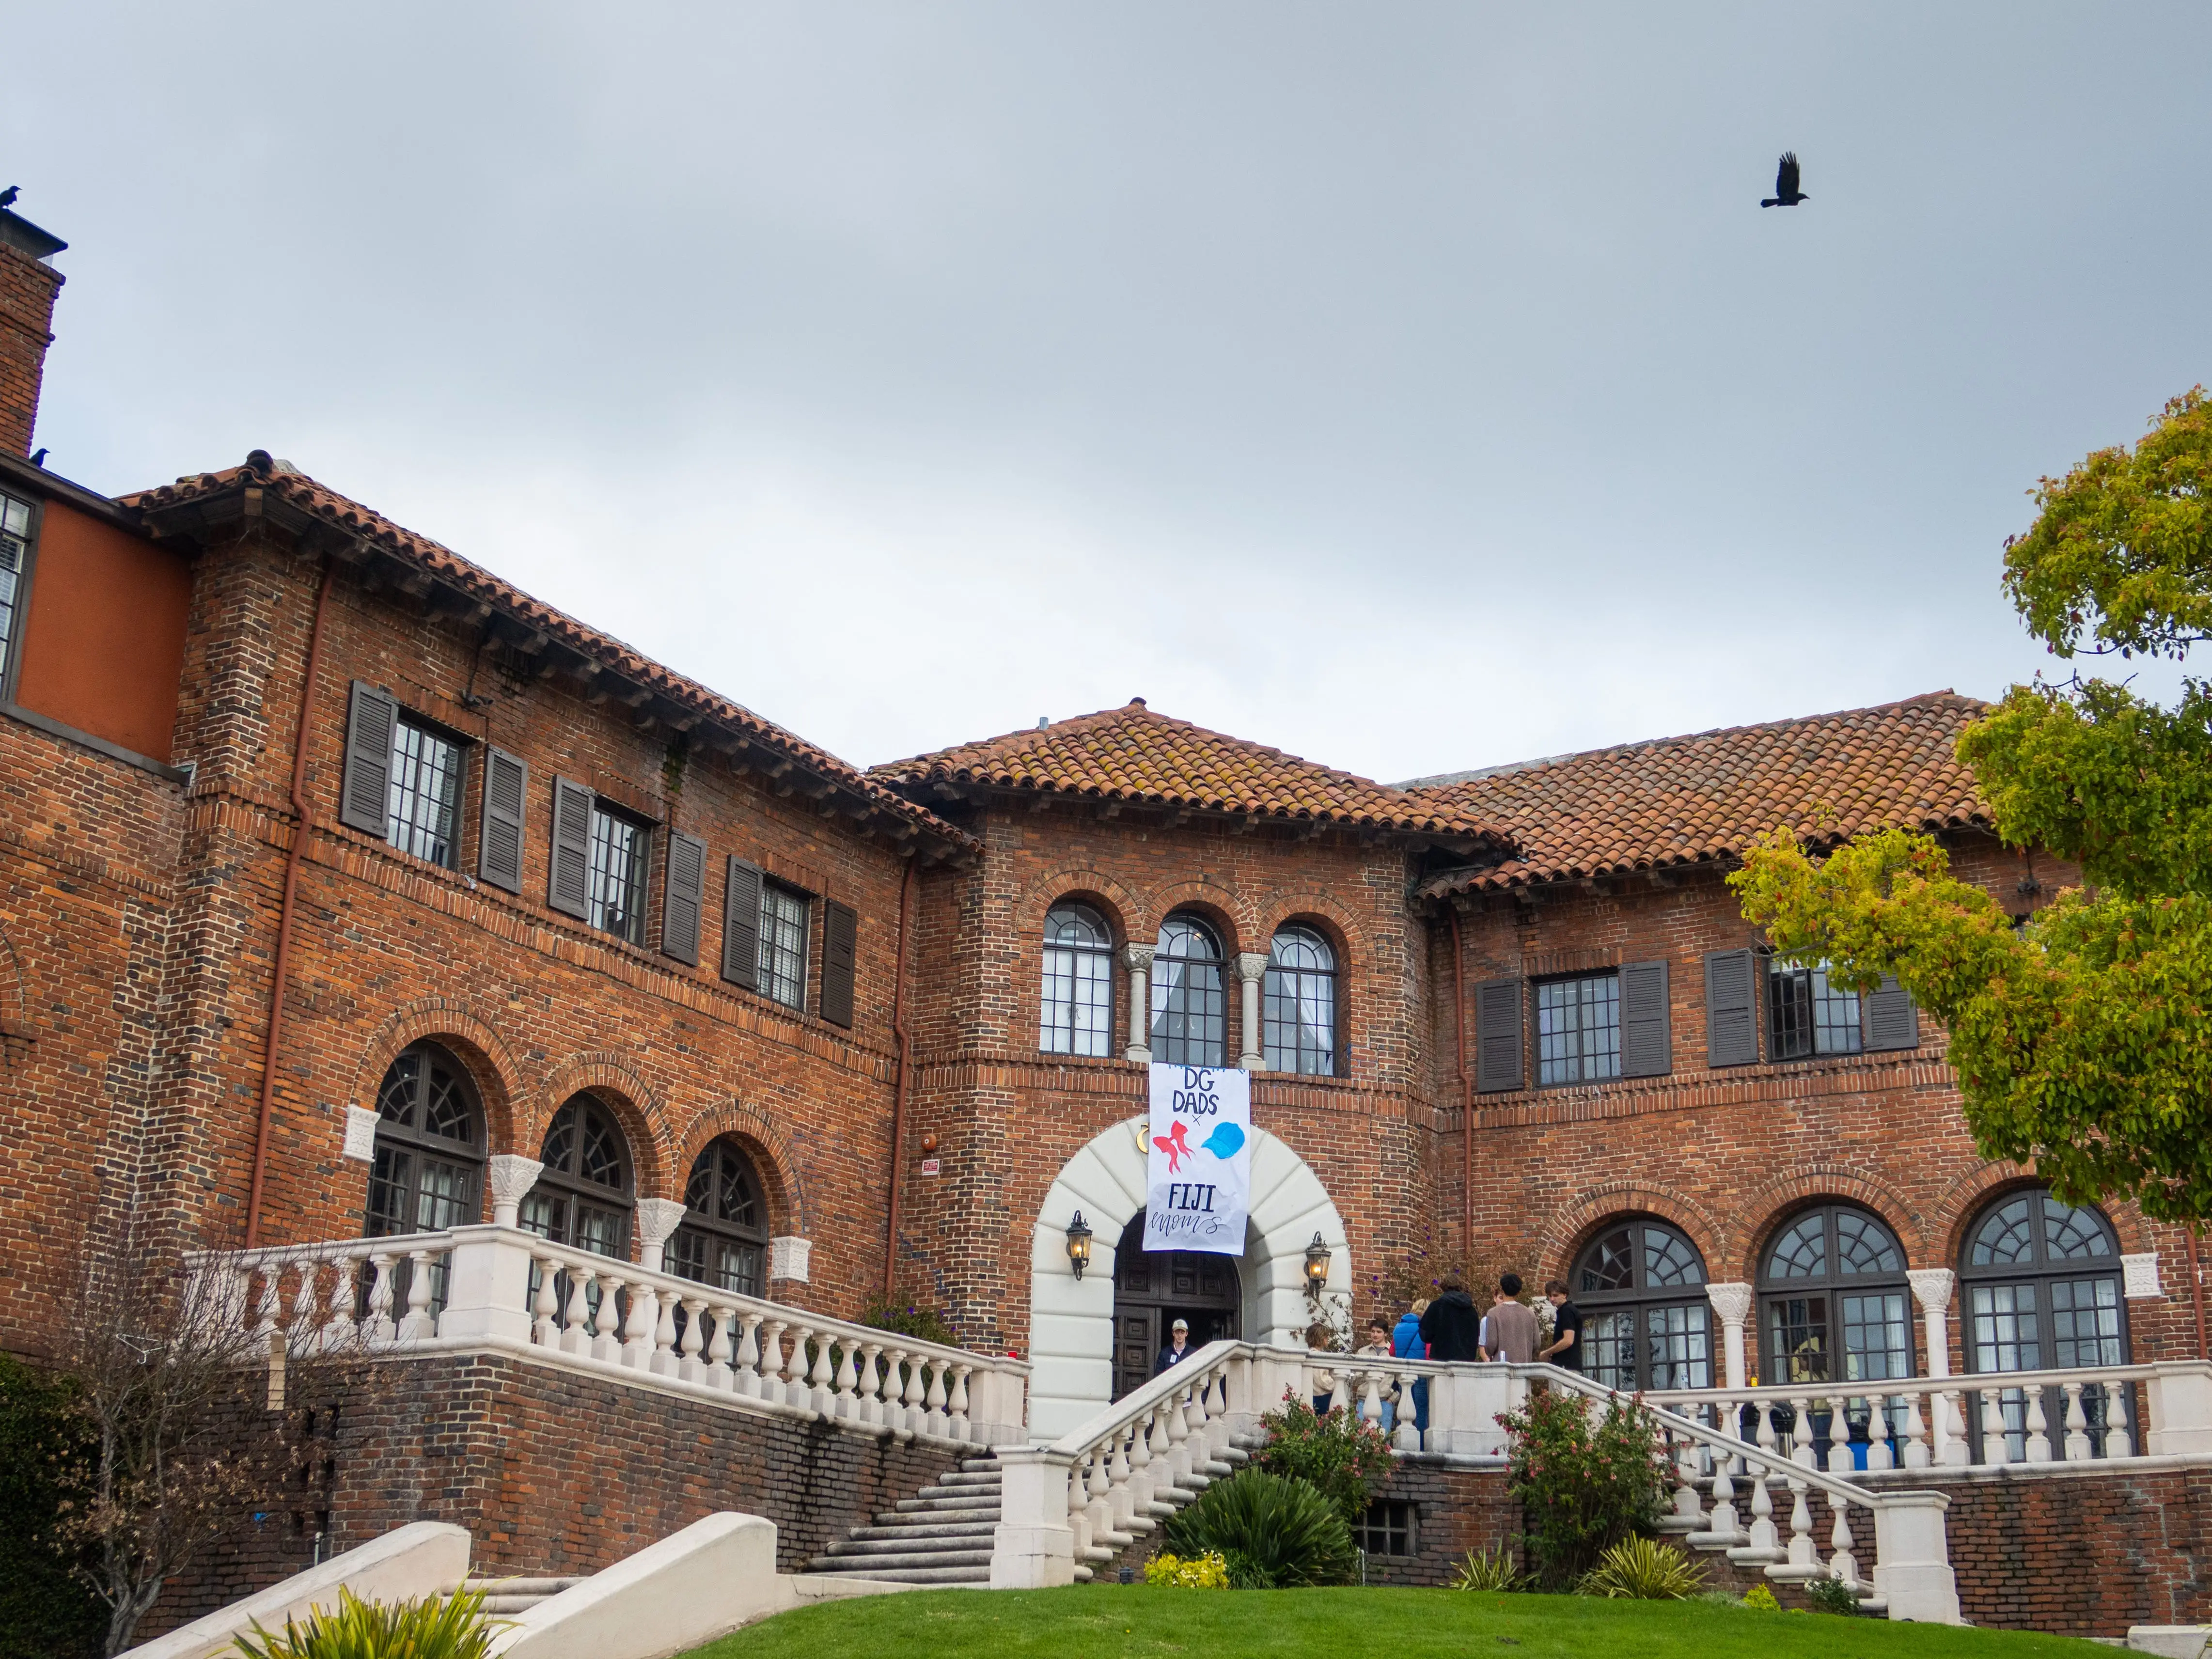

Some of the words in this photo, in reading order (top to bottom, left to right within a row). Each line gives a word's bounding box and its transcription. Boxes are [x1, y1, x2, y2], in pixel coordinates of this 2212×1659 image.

[1185, 1067, 1214, 1091] DG
[1173, 1090, 1219, 1115] DADS
[1168, 1183, 1216, 1212] FIJI
